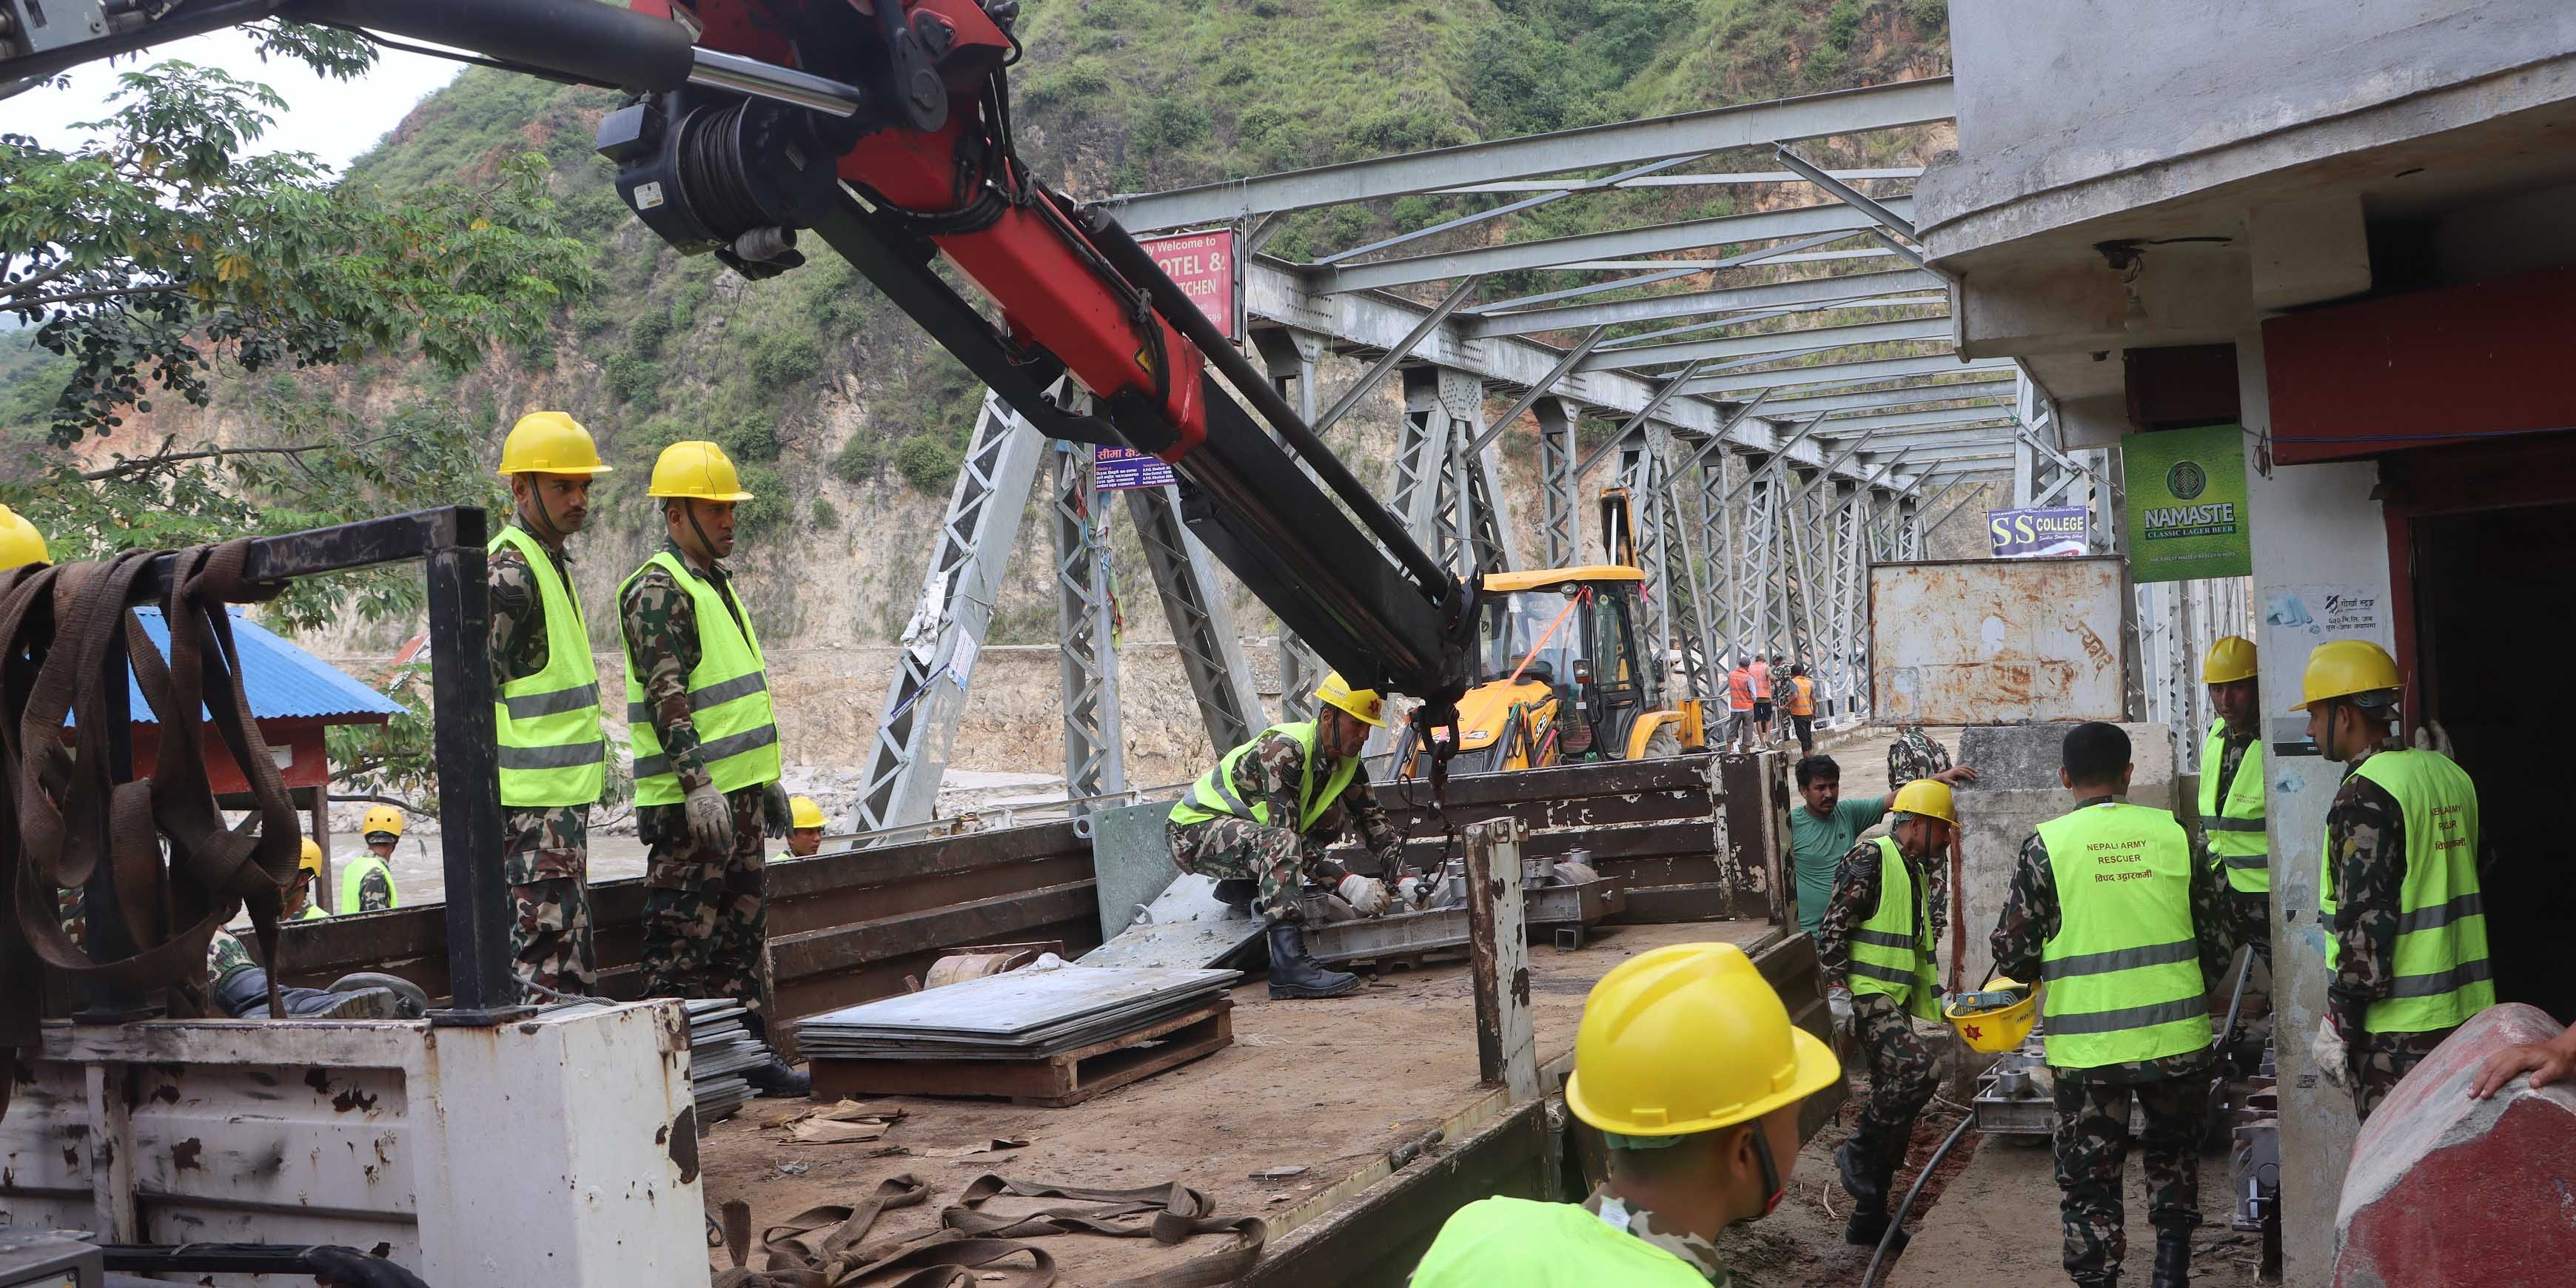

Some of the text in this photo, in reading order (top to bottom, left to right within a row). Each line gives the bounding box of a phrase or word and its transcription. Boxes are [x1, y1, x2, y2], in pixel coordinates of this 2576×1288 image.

[1157, 238, 1203, 252] Welcome
[1206, 236, 1216, 246] to
[1157, 252, 1226, 277] OTEL &
[1097, 448, 1122, 460] सीमा
[2144, 503, 2234, 528] NAMASTE
[2036, 516, 2084, 531] COLLEGE
[2148, 529, 2181, 538] CLASSIC
[2183, 527, 2210, 535] LAGER
[1535, 714, 1548, 739] JCB
[2087, 839, 2147, 852] NEPALI ARMY
[2098, 853, 2141, 865] RESCUER
